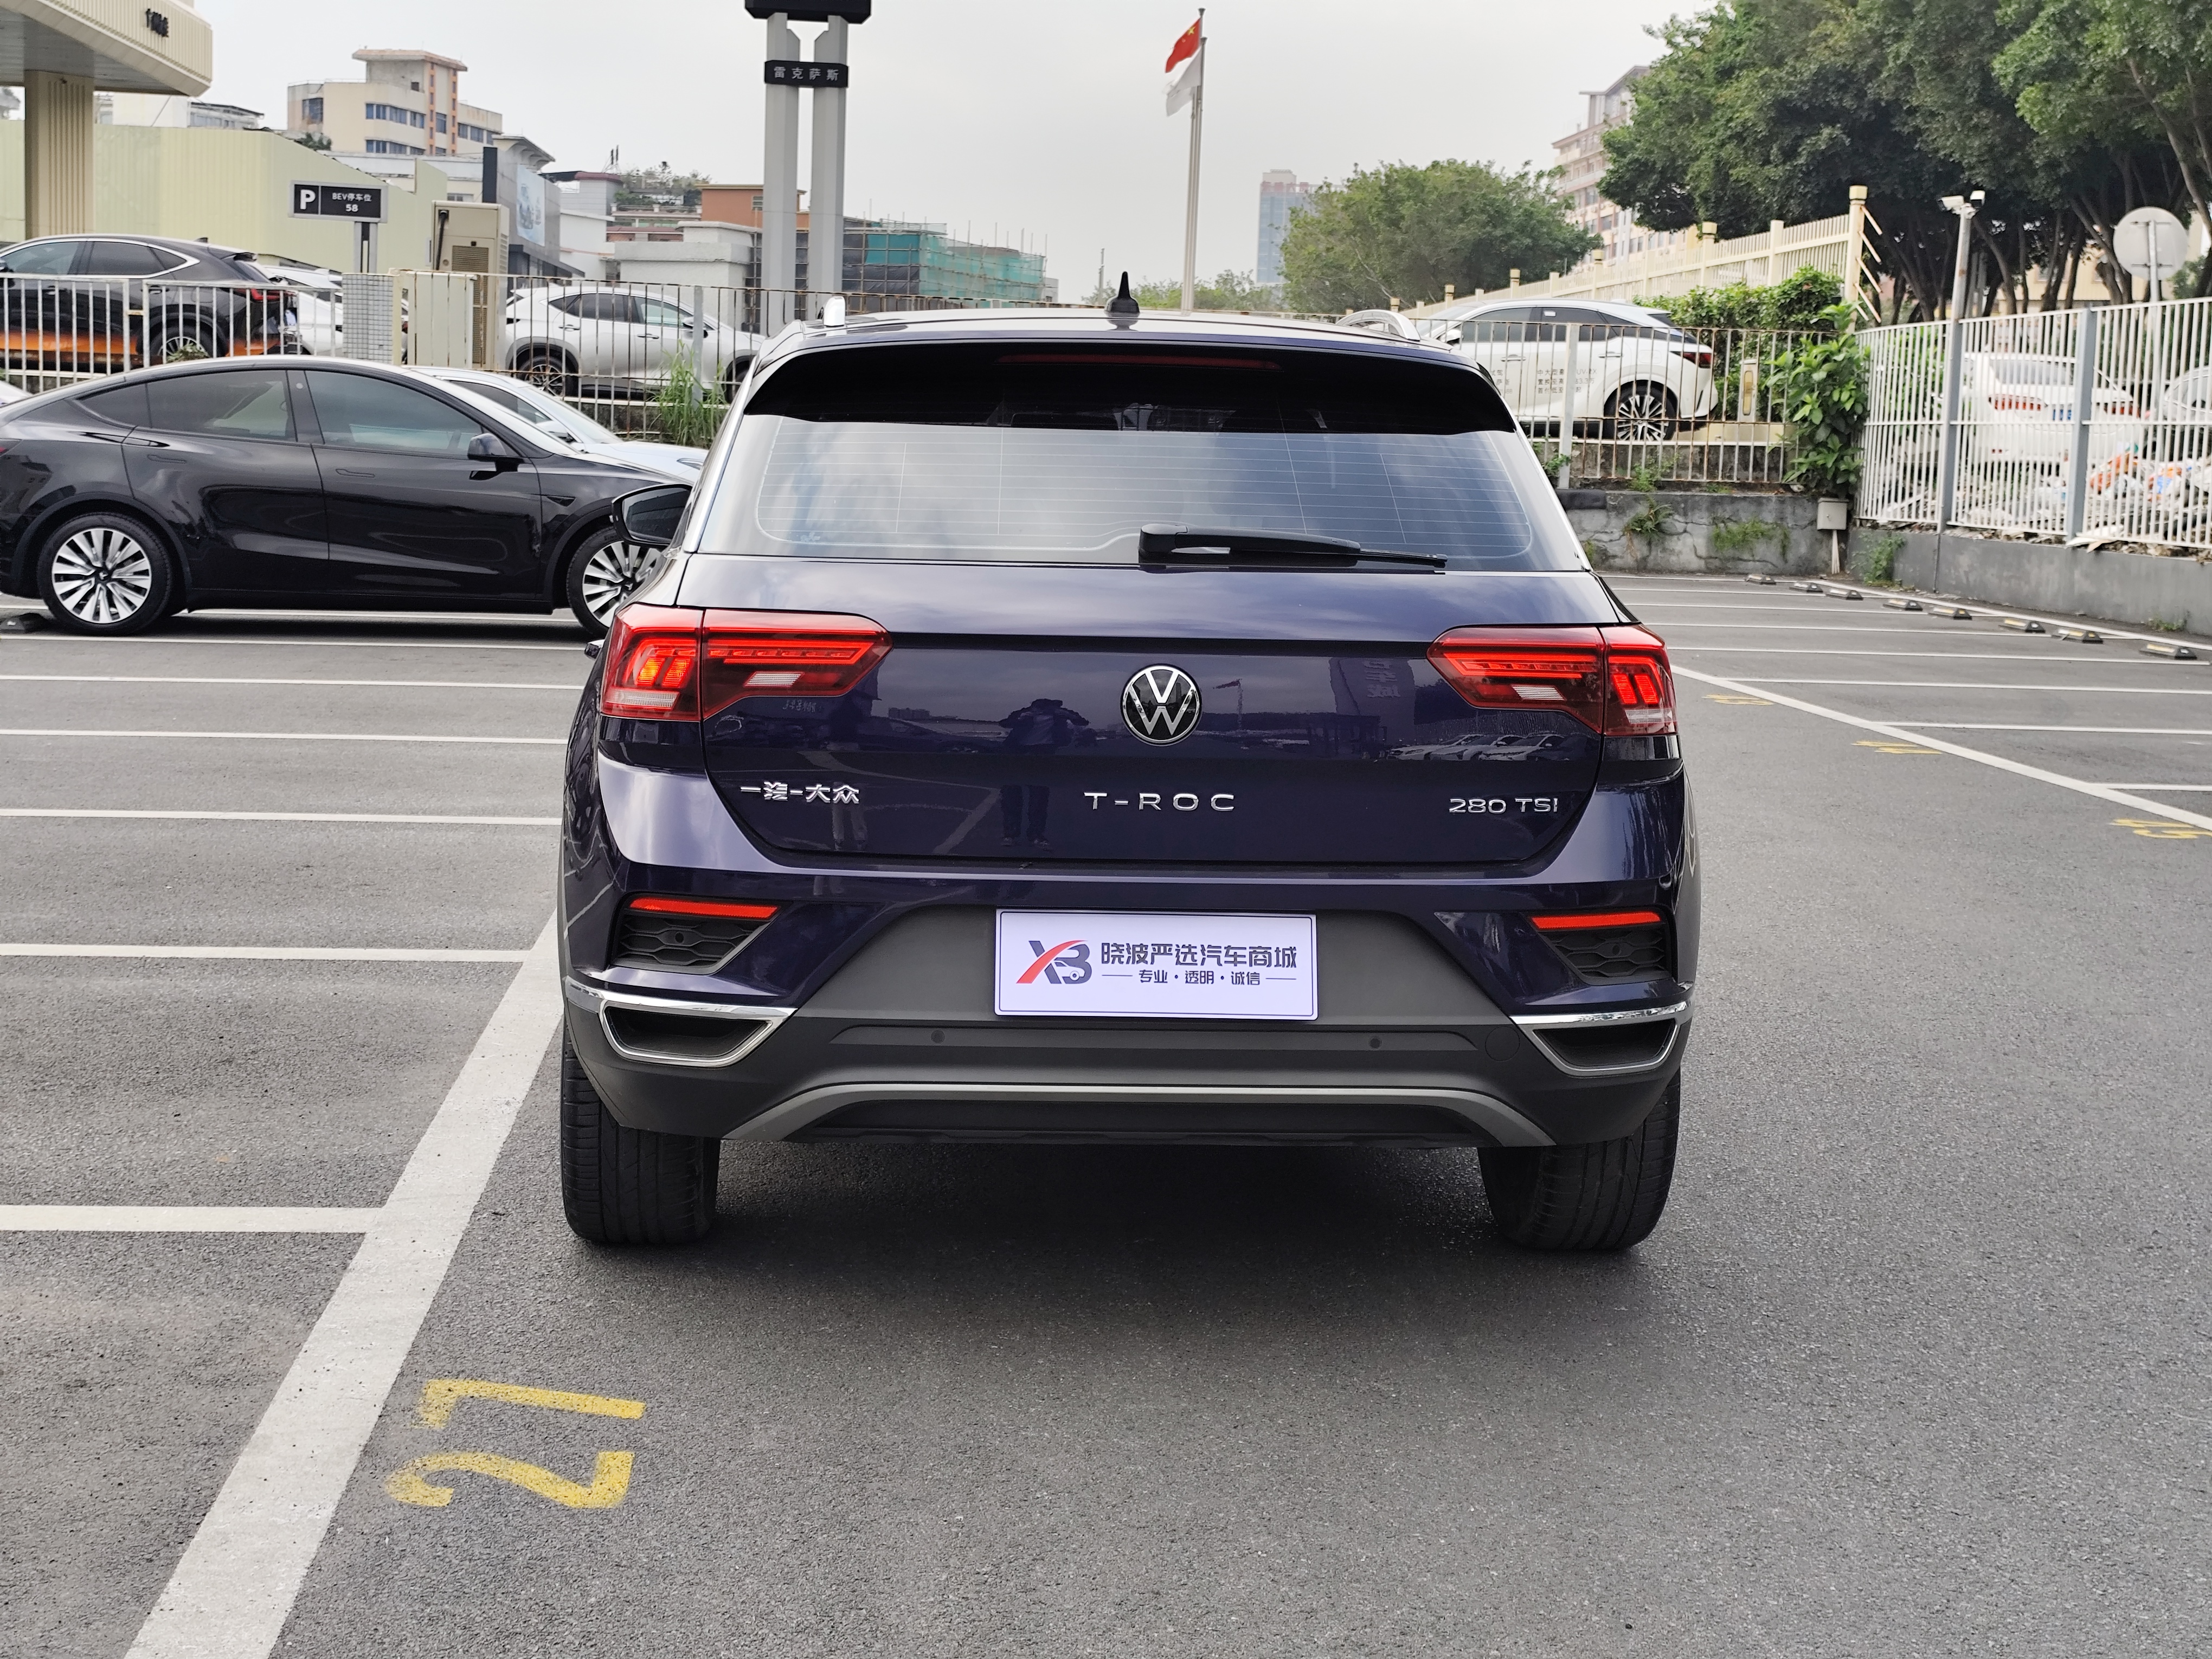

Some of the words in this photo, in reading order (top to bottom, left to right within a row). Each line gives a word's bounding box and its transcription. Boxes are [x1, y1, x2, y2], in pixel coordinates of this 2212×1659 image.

[774, 66, 839, 81] 雷克萨斯
[300, 189, 316, 210] P
[332, 192, 372, 202] BEV停车位
[345, 204, 358, 212] 58
[1084, 792, 1234, 811] T-ROC
[1449, 798, 1507, 813] 280
[1515, 798, 1558, 813] TSI
[1101, 942, 1297, 969] 晓波严选汽车商城
[383, 1379, 647, 1509] 27
